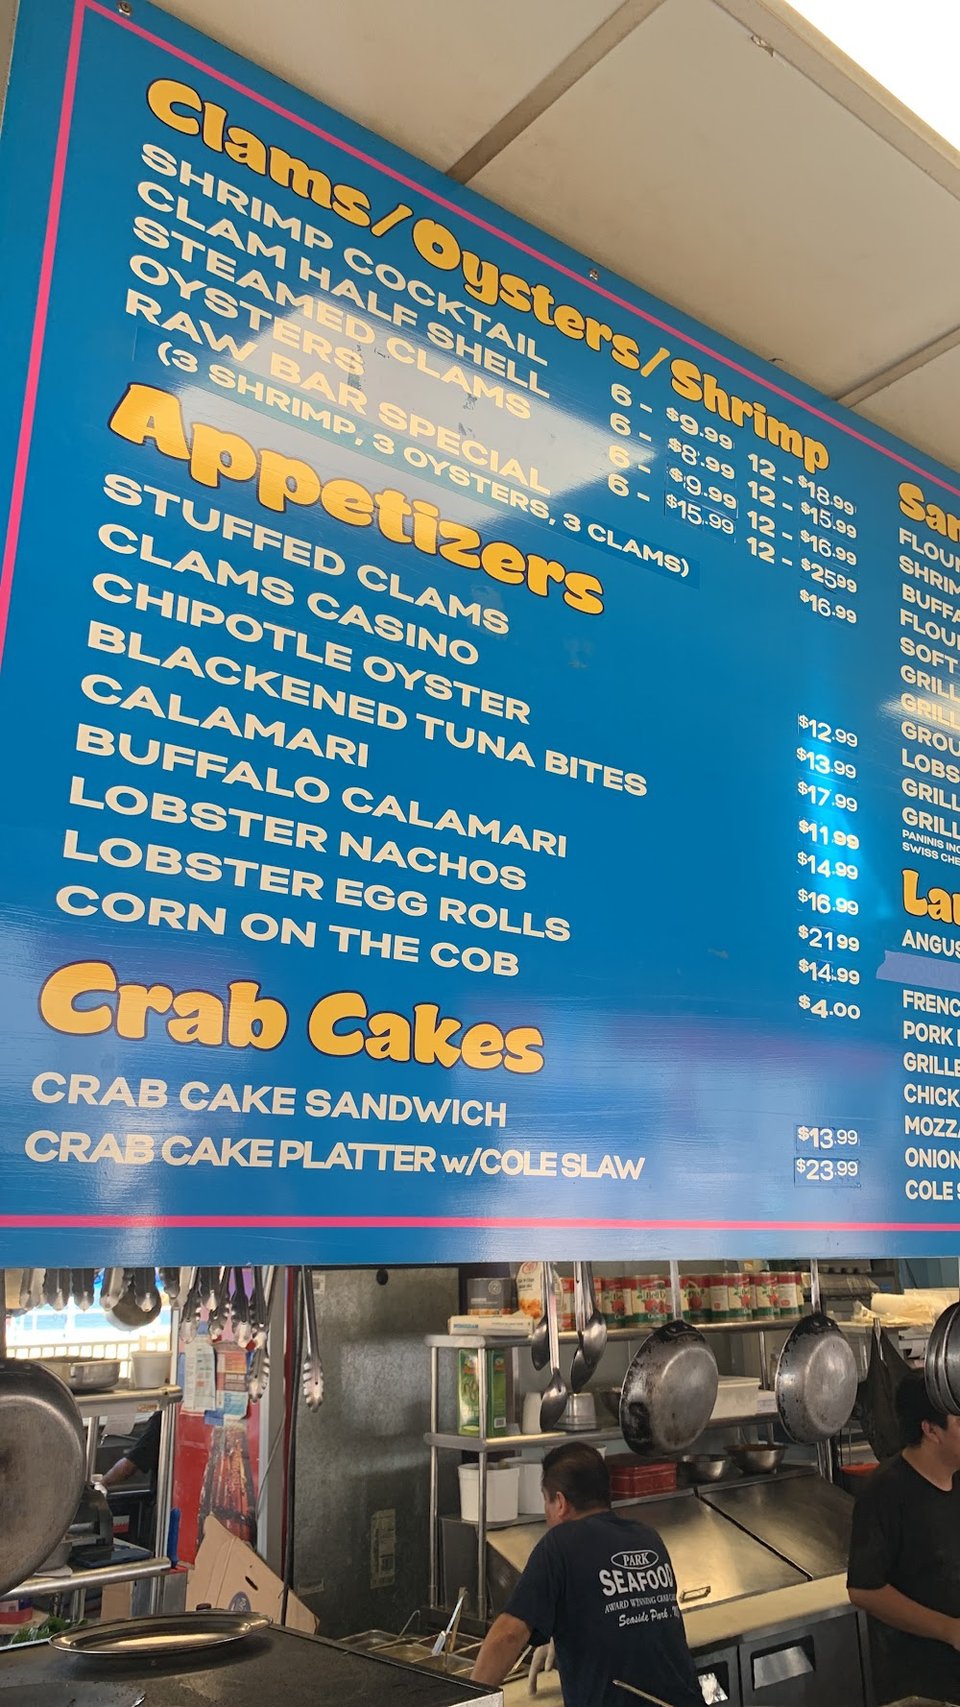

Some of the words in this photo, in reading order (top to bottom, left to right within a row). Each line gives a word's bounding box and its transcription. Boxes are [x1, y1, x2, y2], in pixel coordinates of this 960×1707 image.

[141, 144, 333, 251] SHRIMP
[343, 247, 549, 367] COCKTAIL
[137, 181, 287, 270] CLAM
[299, 264, 418, 329] HALF
[427, 322, 550, 398] SHELL
[129, 254, 365, 376] OYSTERS
[133, 216, 375, 345] STEAMED
[386, 338, 532, 420] CLAMS
[125, 288, 260, 362] RAW
[269, 352, 368, 416] BAR
[378, 402, 551, 496] SPECIAL
[157, 341, 198, 374] (3
[208, 364, 363, 447] SHRIMP,
[373, 433, 394, 455] 3
[404, 446, 557, 525] OYSTERS,
[563, 512, 581, 532] 3
[587, 523, 689, 578] CLAMS)
[611, 383, 632, 407] 6
[666, 407, 733, 450] $9.99
[747, 453, 776, 481] 12
[798, 475, 854, 516] $18.99
[610, 412, 631, 436] 6
[668, 437, 735, 480] $8.99
[747, 480, 776, 509] 12
[801, 501, 857, 539] $15.99
[107, 383, 604, 615] Appetizers
[609, 445, 630, 469] 6
[669, 467, 737, 509] $9.99
[747, 510, 775, 539] 12
[800, 529, 857, 566] $16.99
[608, 473, 629, 497] 6
[666, 494, 734, 535] $15.99
[747, 537, 775, 564] 12
[103, 473, 346, 576] STUFFED
[357, 564, 509, 634] CLAMS
[98, 523, 295, 606] CLAMS
[307, 592, 479, 665] CASINO
[800, 589, 857, 624] $16.99
[900, 608, 960, 652] FLOU
[92, 573, 353, 672] CHIPOTLE
[363, 656, 531, 725] OYSTER
[900, 637, 958, 674] SOFT
[900, 665, 960, 703] GRILL
[80, 674, 369, 768] CALAMARI
[87, 620, 407, 731] BLACKENED
[415, 713, 536, 768] TUNA
[545, 749, 648, 797] BITES
[798, 714, 858, 747] $12.99
[901, 721, 960, 757] GROU
[796, 747, 857, 779] $13.99
[902, 748, 960, 784] LOBS
[75, 723, 330, 804] BUFFALO
[341, 786, 567, 858] CALAMARI
[797, 781, 858, 812] $17.99
[902, 778, 960, 812] GRILL
[69, 775, 328, 853] LOBSTER
[339, 831, 527, 891] NACHOS
[798, 819, 860, 850] $11.99
[902, 807, 960, 840] GRILL
[902, 829, 944, 849] PANINIS
[797, 851, 858, 880] $14.99
[902, 842, 939, 860] SWISS
[62, 829, 324, 900] LOBSTER
[335, 878, 428, 917] EGG
[439, 896, 571, 942] ROLLS
[797, 888, 859, 916] $16.99
[55, 885, 227, 936] CORN
[240, 912, 317, 948] ON
[328, 924, 420, 963] THE
[430, 942, 519, 977] COB
[798, 958, 860, 985] $14.99
[38, 959, 289, 1051] Crab
[307, 990, 545, 1075] Cakes
[798, 994, 861, 1020] $4.00
[903, 989, 960, 1018] FRENC
[903, 1020, 954, 1046] PORK
[31, 1072, 168, 1109] CRAB
[179, 1081, 296, 1116] CAKE
[305, 1089, 507, 1127] SANDWICH
[903, 1083, 960, 1108] CHICK
[797, 1126, 858, 1149] $13.99
[904, 1115, 960, 1138] MOZZ
[24, 1130, 155, 1165] CRAB
[161, 1135, 274, 1168] CAKE
[278, 1140, 436, 1172] PLATTER
[905, 1147, 960, 1170] ONION
[796, 1158, 858, 1181] $23.99
[905, 1179, 954, 1200] COLE
[622, 1552, 650, 1567] PARK
[599, 1563, 674, 1597] SEAFOOD
[604, 1600, 629, 1614] AWARD
